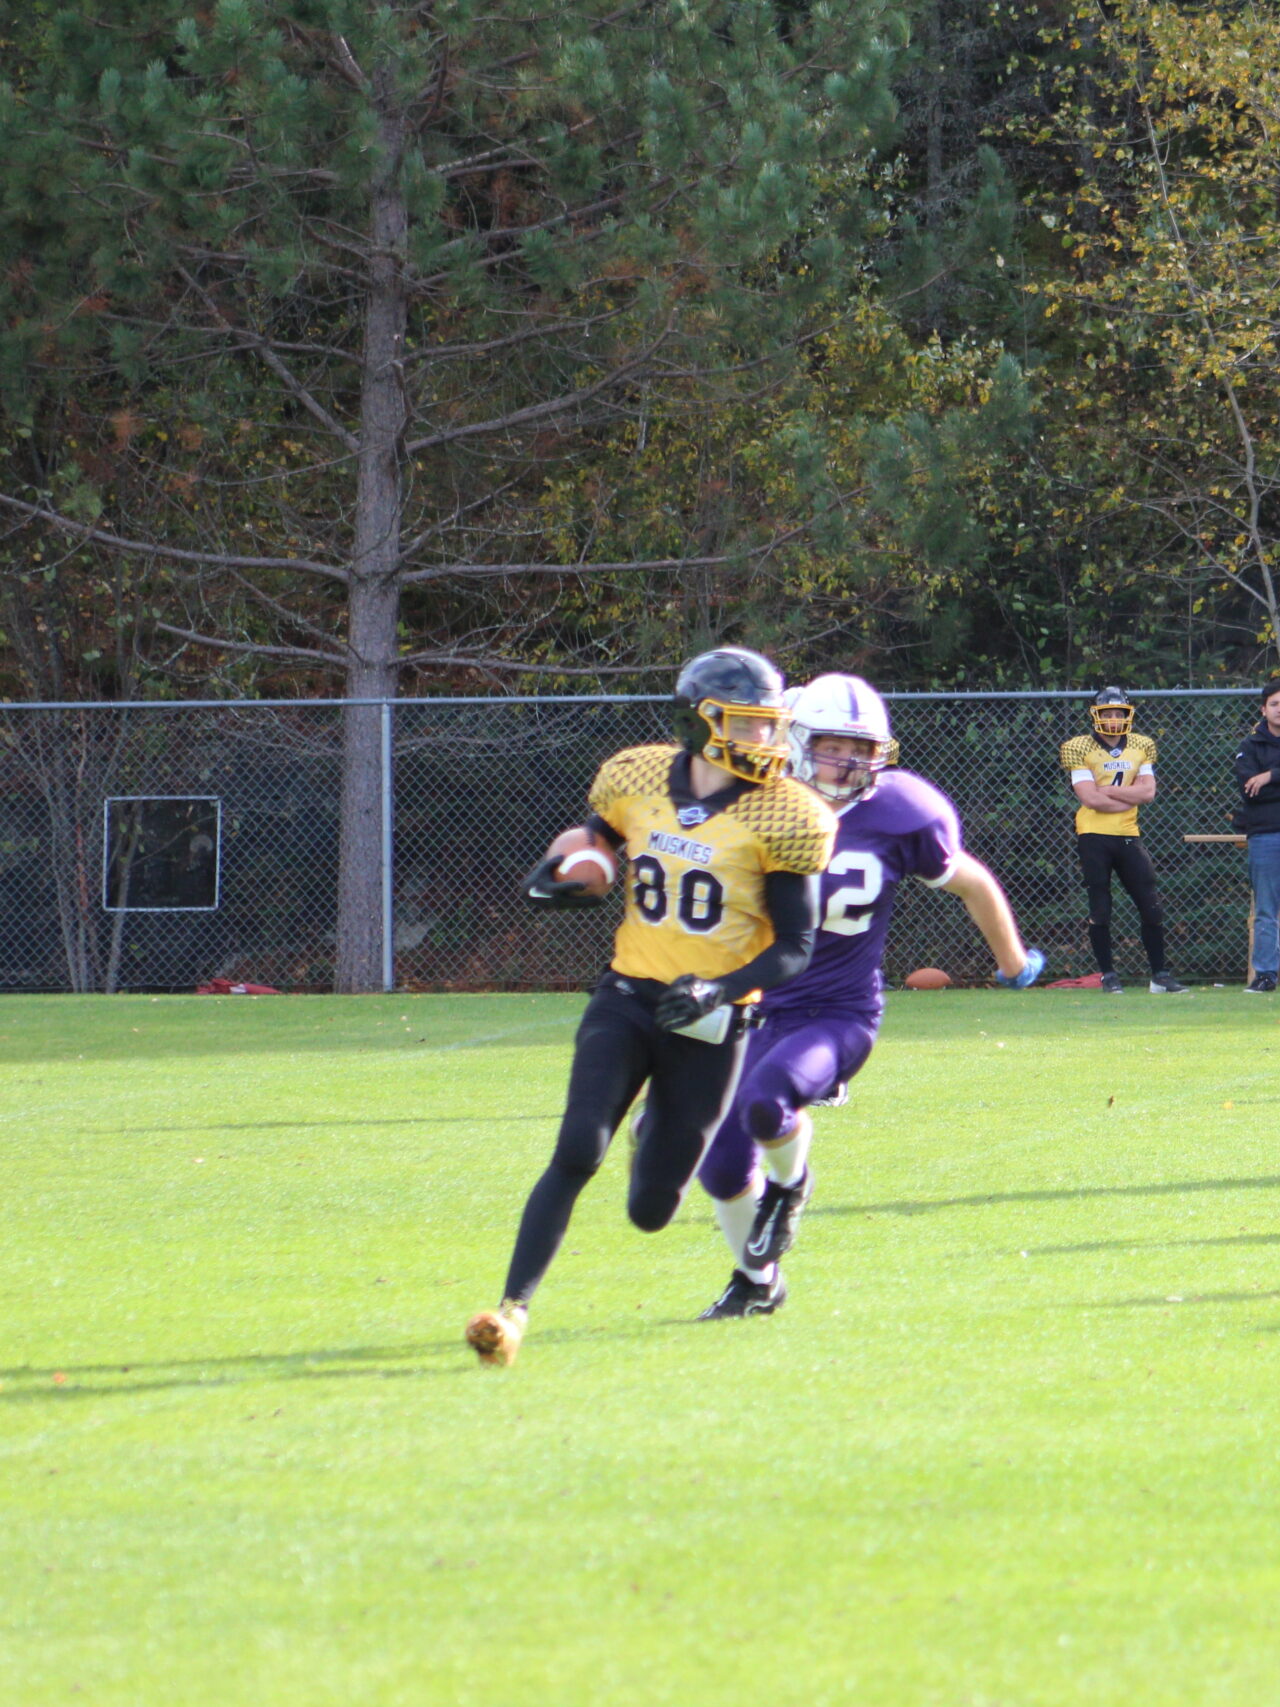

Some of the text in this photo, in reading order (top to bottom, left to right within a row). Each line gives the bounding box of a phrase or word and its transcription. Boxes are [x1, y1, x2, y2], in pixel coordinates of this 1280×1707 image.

[649, 830, 713, 865] MUSKIES
[631, 853, 725, 935] 80
[808, 850, 884, 937] 2
